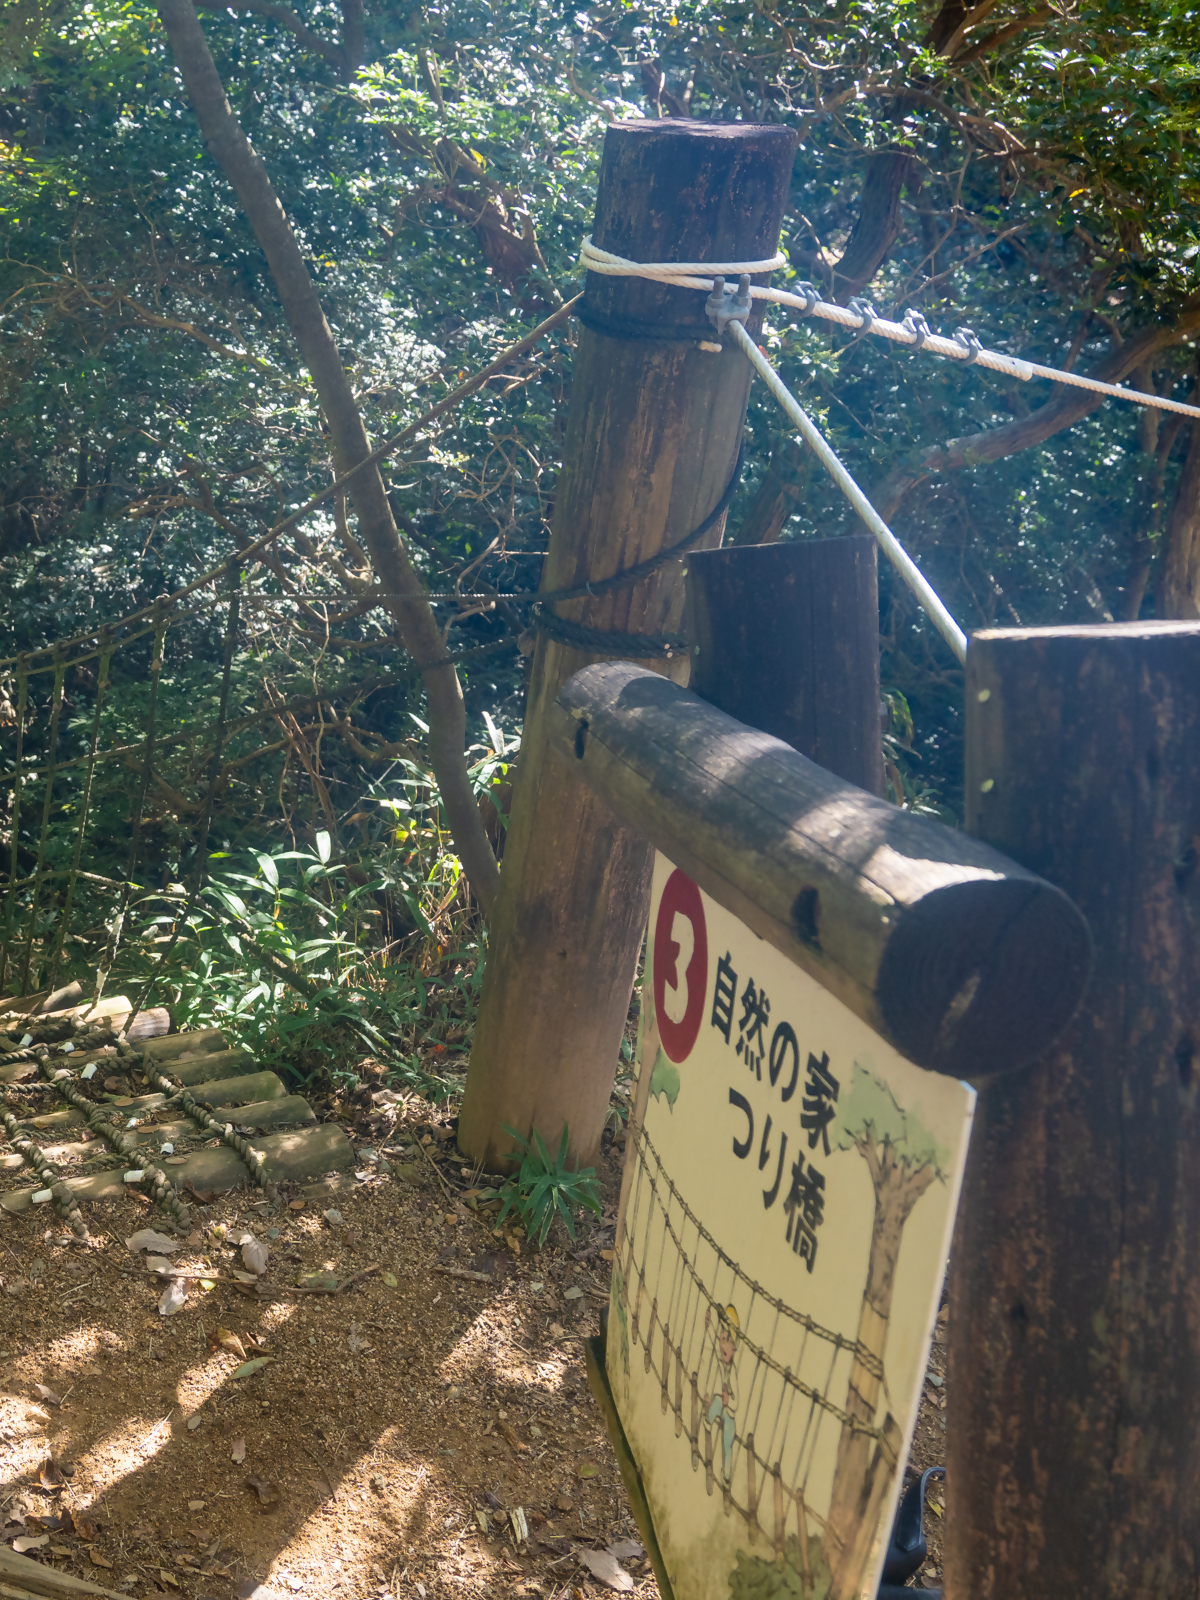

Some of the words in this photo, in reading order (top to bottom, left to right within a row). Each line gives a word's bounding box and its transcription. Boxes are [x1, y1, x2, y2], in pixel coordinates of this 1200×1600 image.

[664, 910, 695, 1024] 3
[711, 950, 840, 1156] 自然の家
[729, 1087, 826, 1273] つり橋
